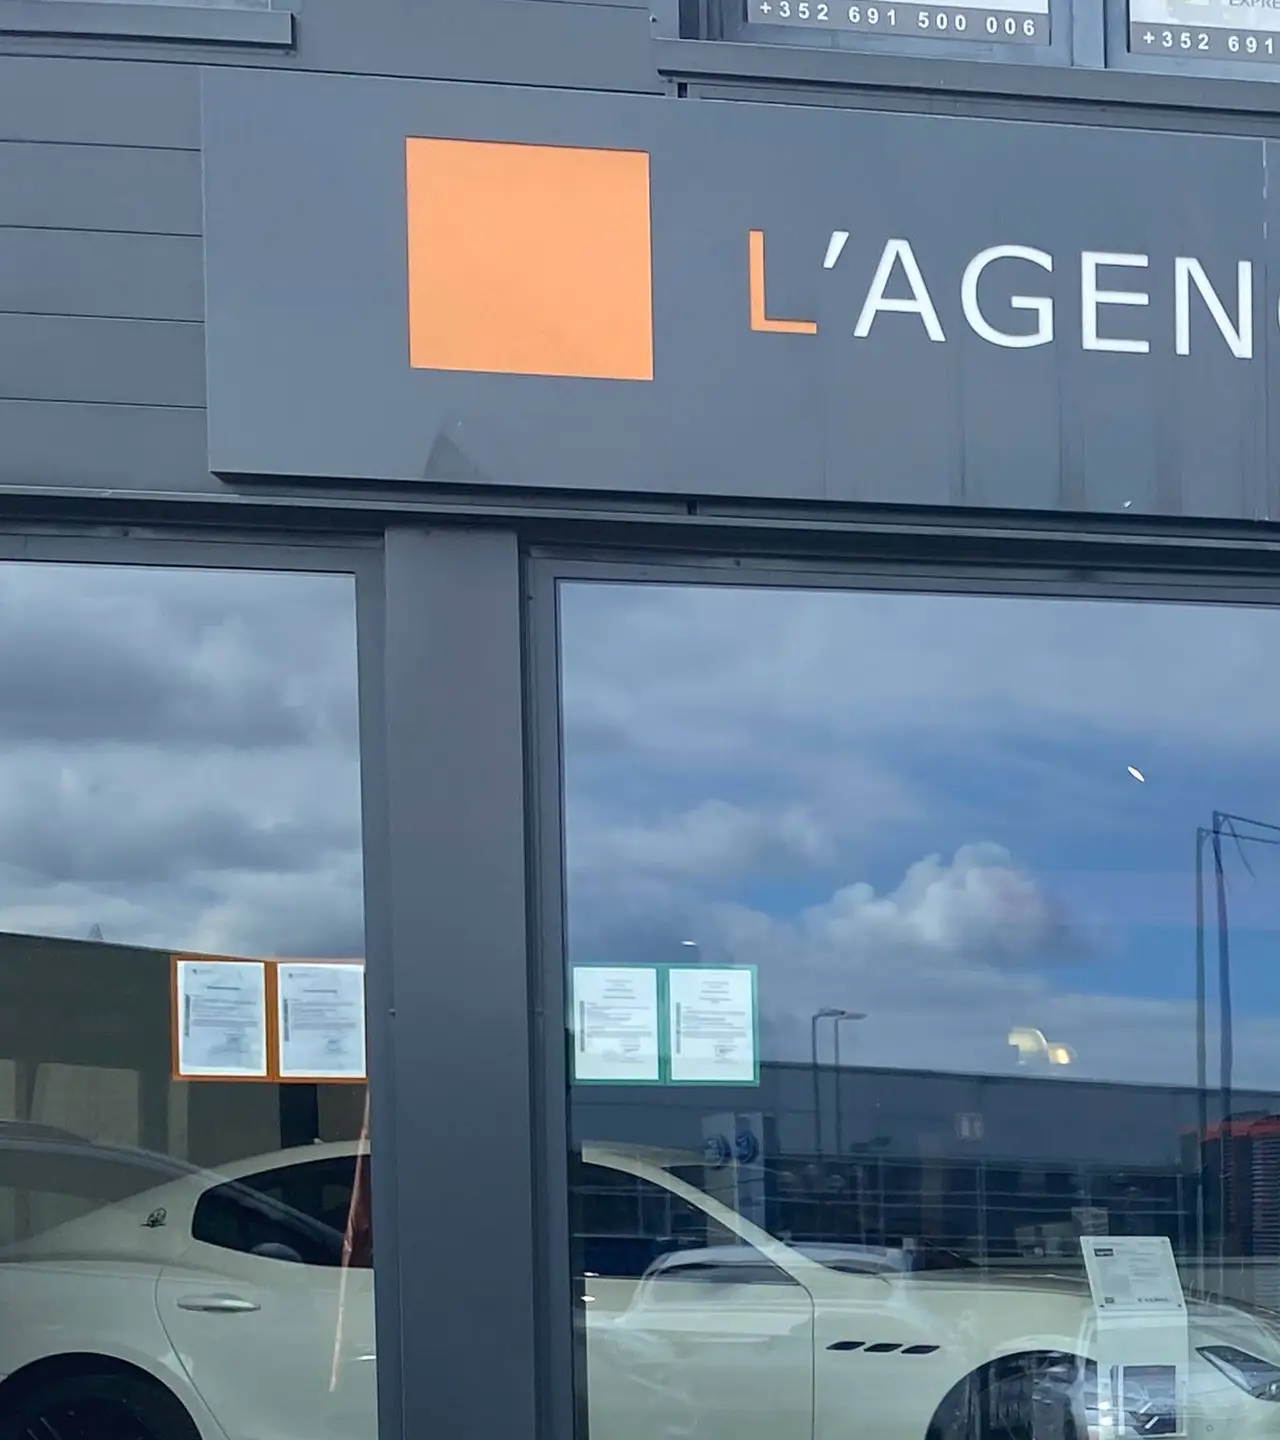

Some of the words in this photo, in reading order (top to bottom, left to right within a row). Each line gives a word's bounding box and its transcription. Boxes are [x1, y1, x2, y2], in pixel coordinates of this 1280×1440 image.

[848, 9, 897, 26] 691
[917, 11, 967, 31] 500
[985, 16, 1036, 37] 006
[1143, 30, 1210, 51] +352
[1227, 35, 1276, 54] 691
